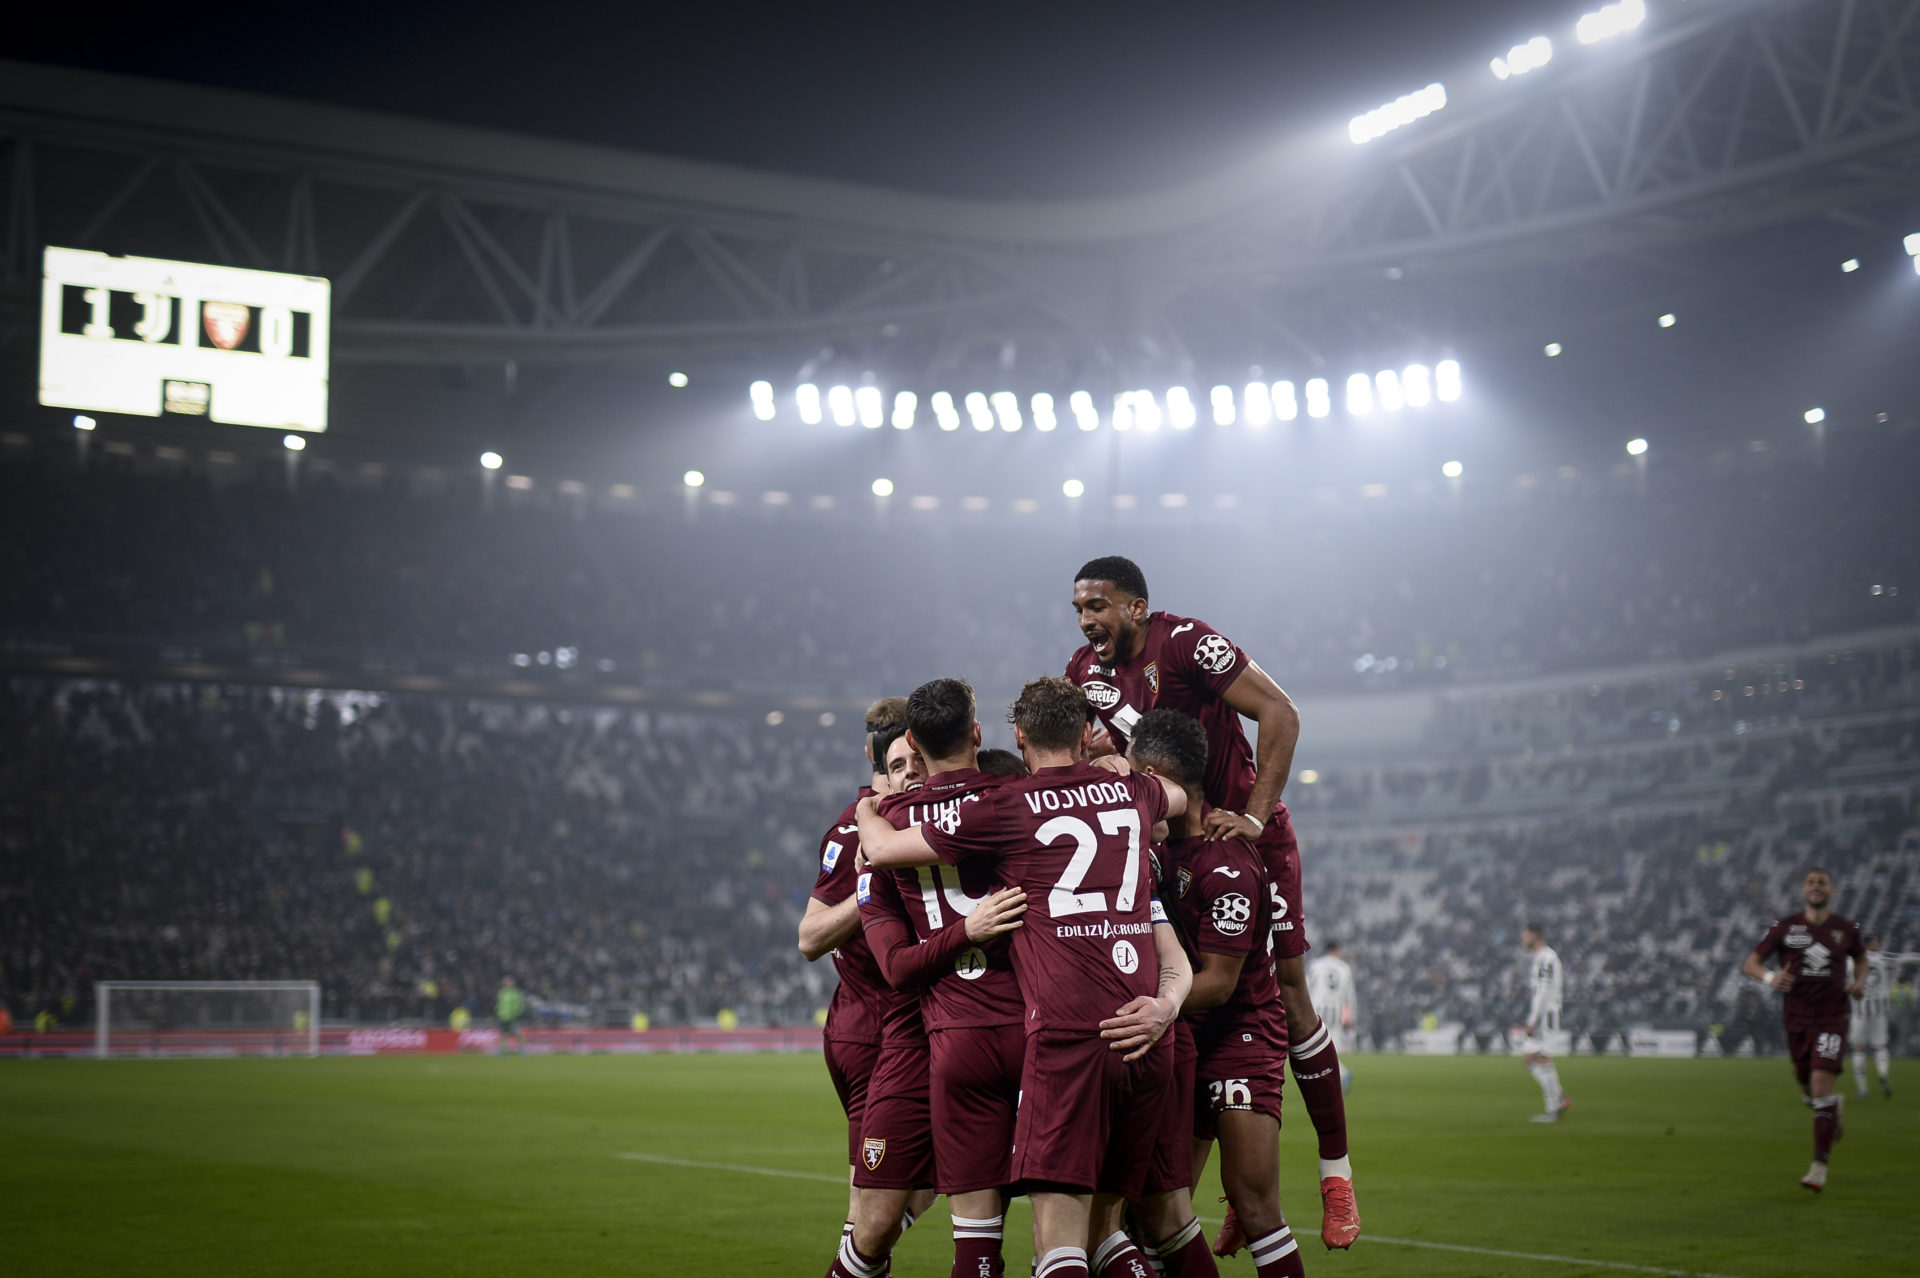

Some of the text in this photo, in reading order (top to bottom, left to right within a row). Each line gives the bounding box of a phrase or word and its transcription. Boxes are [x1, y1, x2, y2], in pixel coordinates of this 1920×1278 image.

[83, 287, 114, 340] 1
[259, 304, 293, 357] 0
[1025, 781, 1132, 814] VOJVODA
[1034, 808, 1141, 918] 27
[1212, 897, 1250, 921] 38
[1217, 920, 1245, 931] Wüber
[1115, 946, 1137, 968] EA
[978, 1256, 990, 1278] TOR
[1126, 1258, 1149, 1278] TOR
